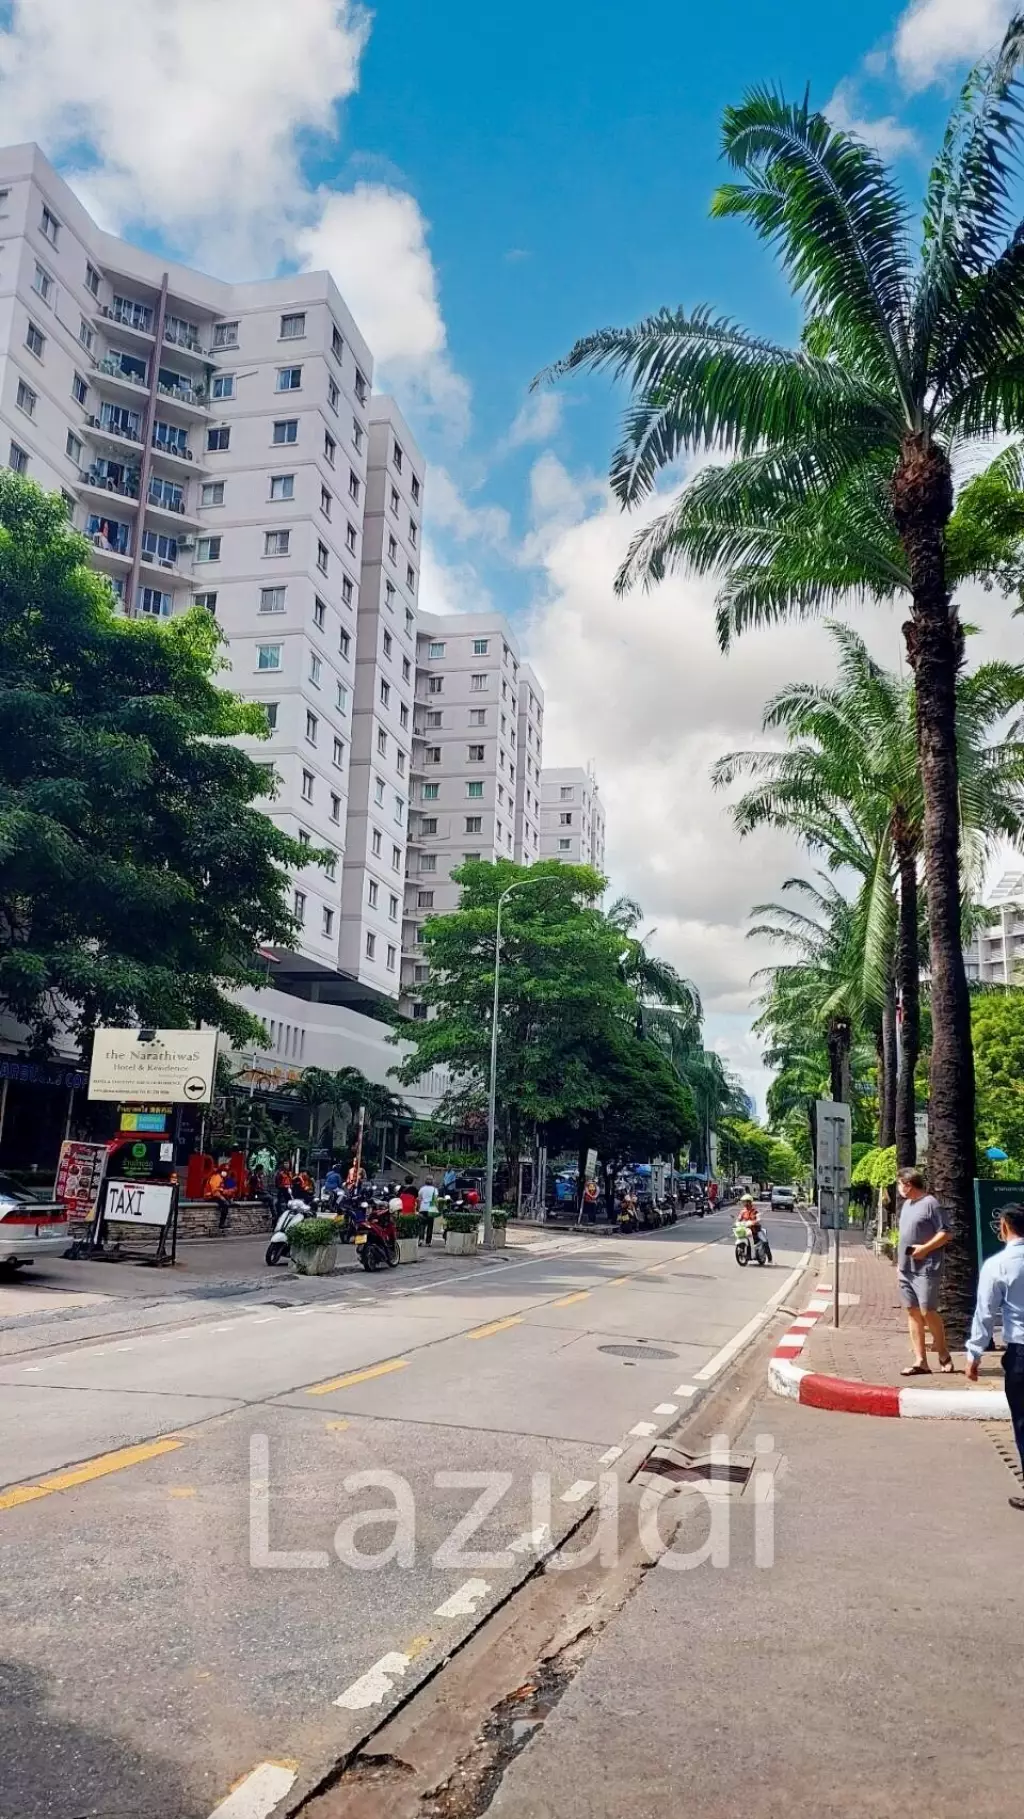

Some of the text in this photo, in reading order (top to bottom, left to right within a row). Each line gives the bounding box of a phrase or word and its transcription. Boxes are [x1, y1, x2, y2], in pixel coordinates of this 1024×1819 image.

[105, 1049, 200, 1062] the NarathiwaS
[113, 1064, 189, 1073] Hotel & Residence
[109, 1188, 145, 1216] TAXI
